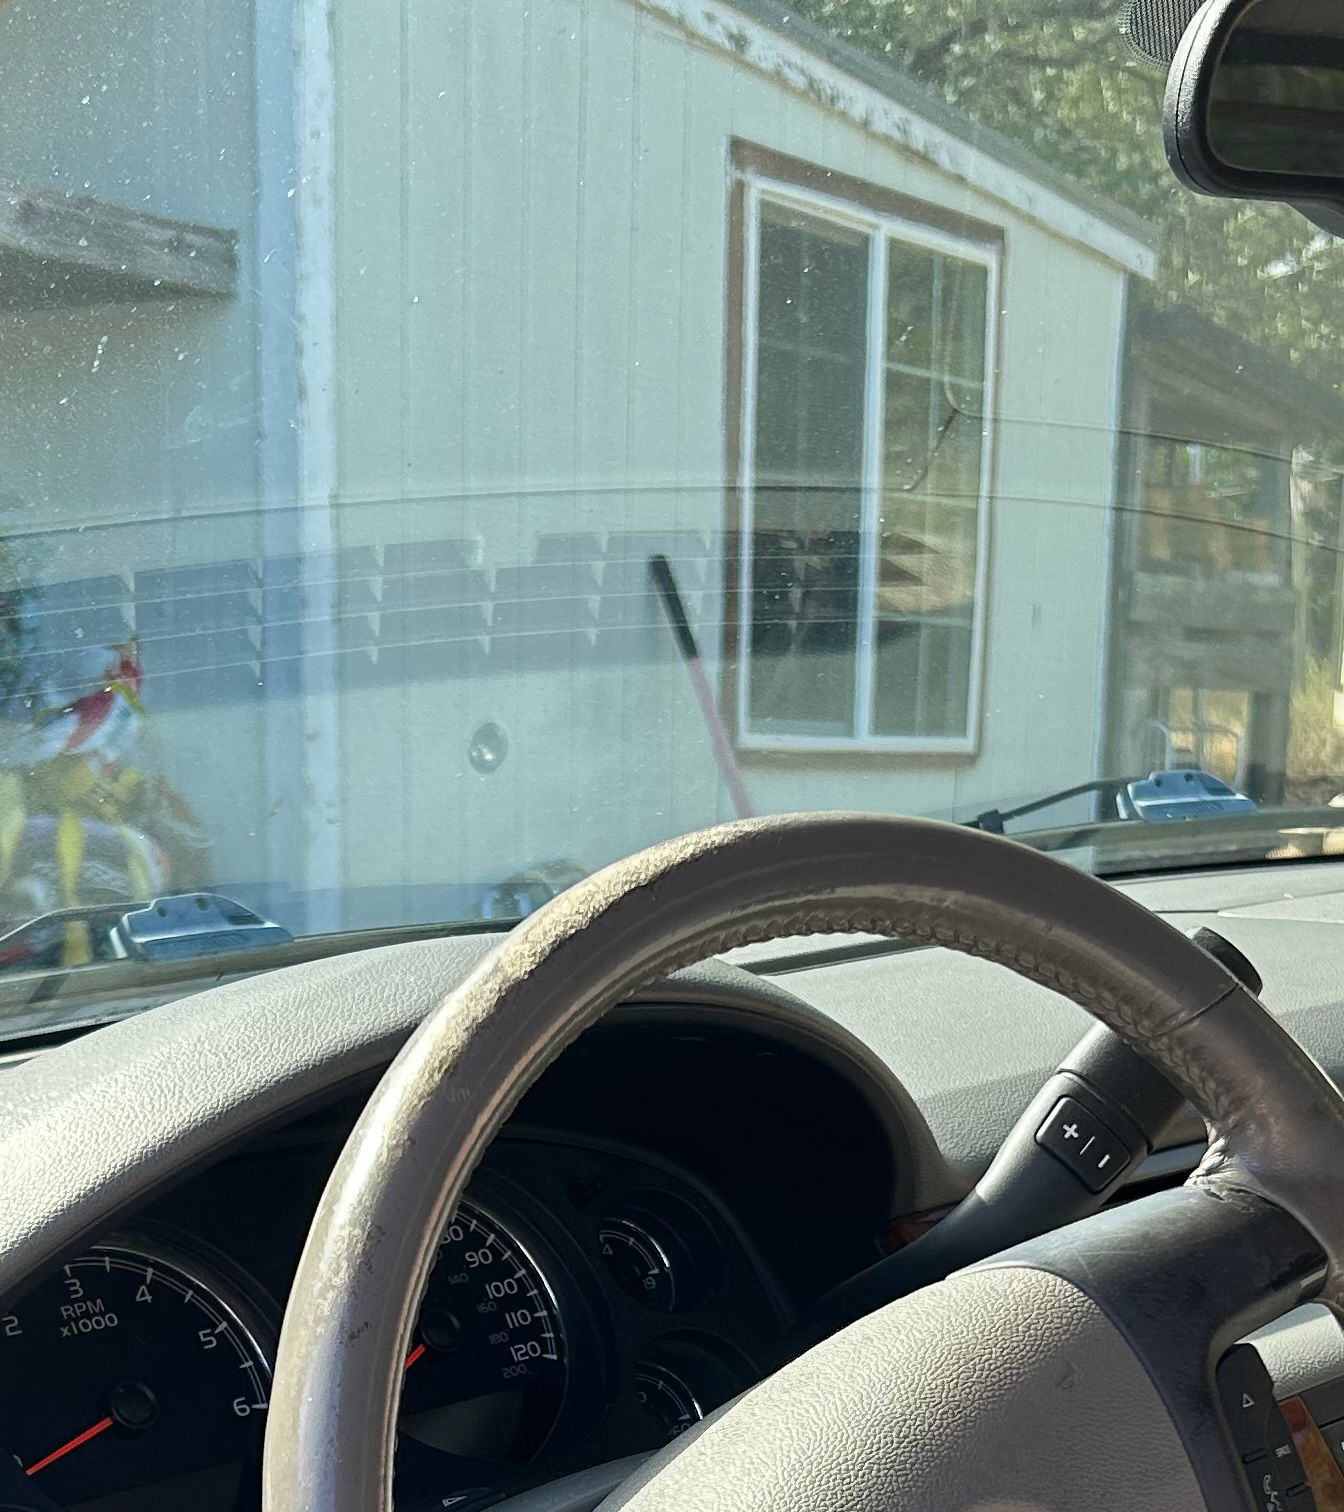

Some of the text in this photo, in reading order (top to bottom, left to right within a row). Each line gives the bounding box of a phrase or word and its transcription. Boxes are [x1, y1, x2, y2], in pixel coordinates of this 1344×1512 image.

[465, 1248, 493, 1268] 90
[65, 1279, 84, 1298] 3
[135, 1284, 153, 1303] 4
[485, 1278, 518, 1299] 100
[61, 1298, 105, 1320] RPM
[505, 1309, 531, 1328] 110
[1, 1316, 22, 1337] 2
[60, 1312, 119, 1338] x1000
[198, 1329, 218, 1349] 5
[509, 1341, 541, 1362] 120
[232, 1398, 251, 1417] 6
